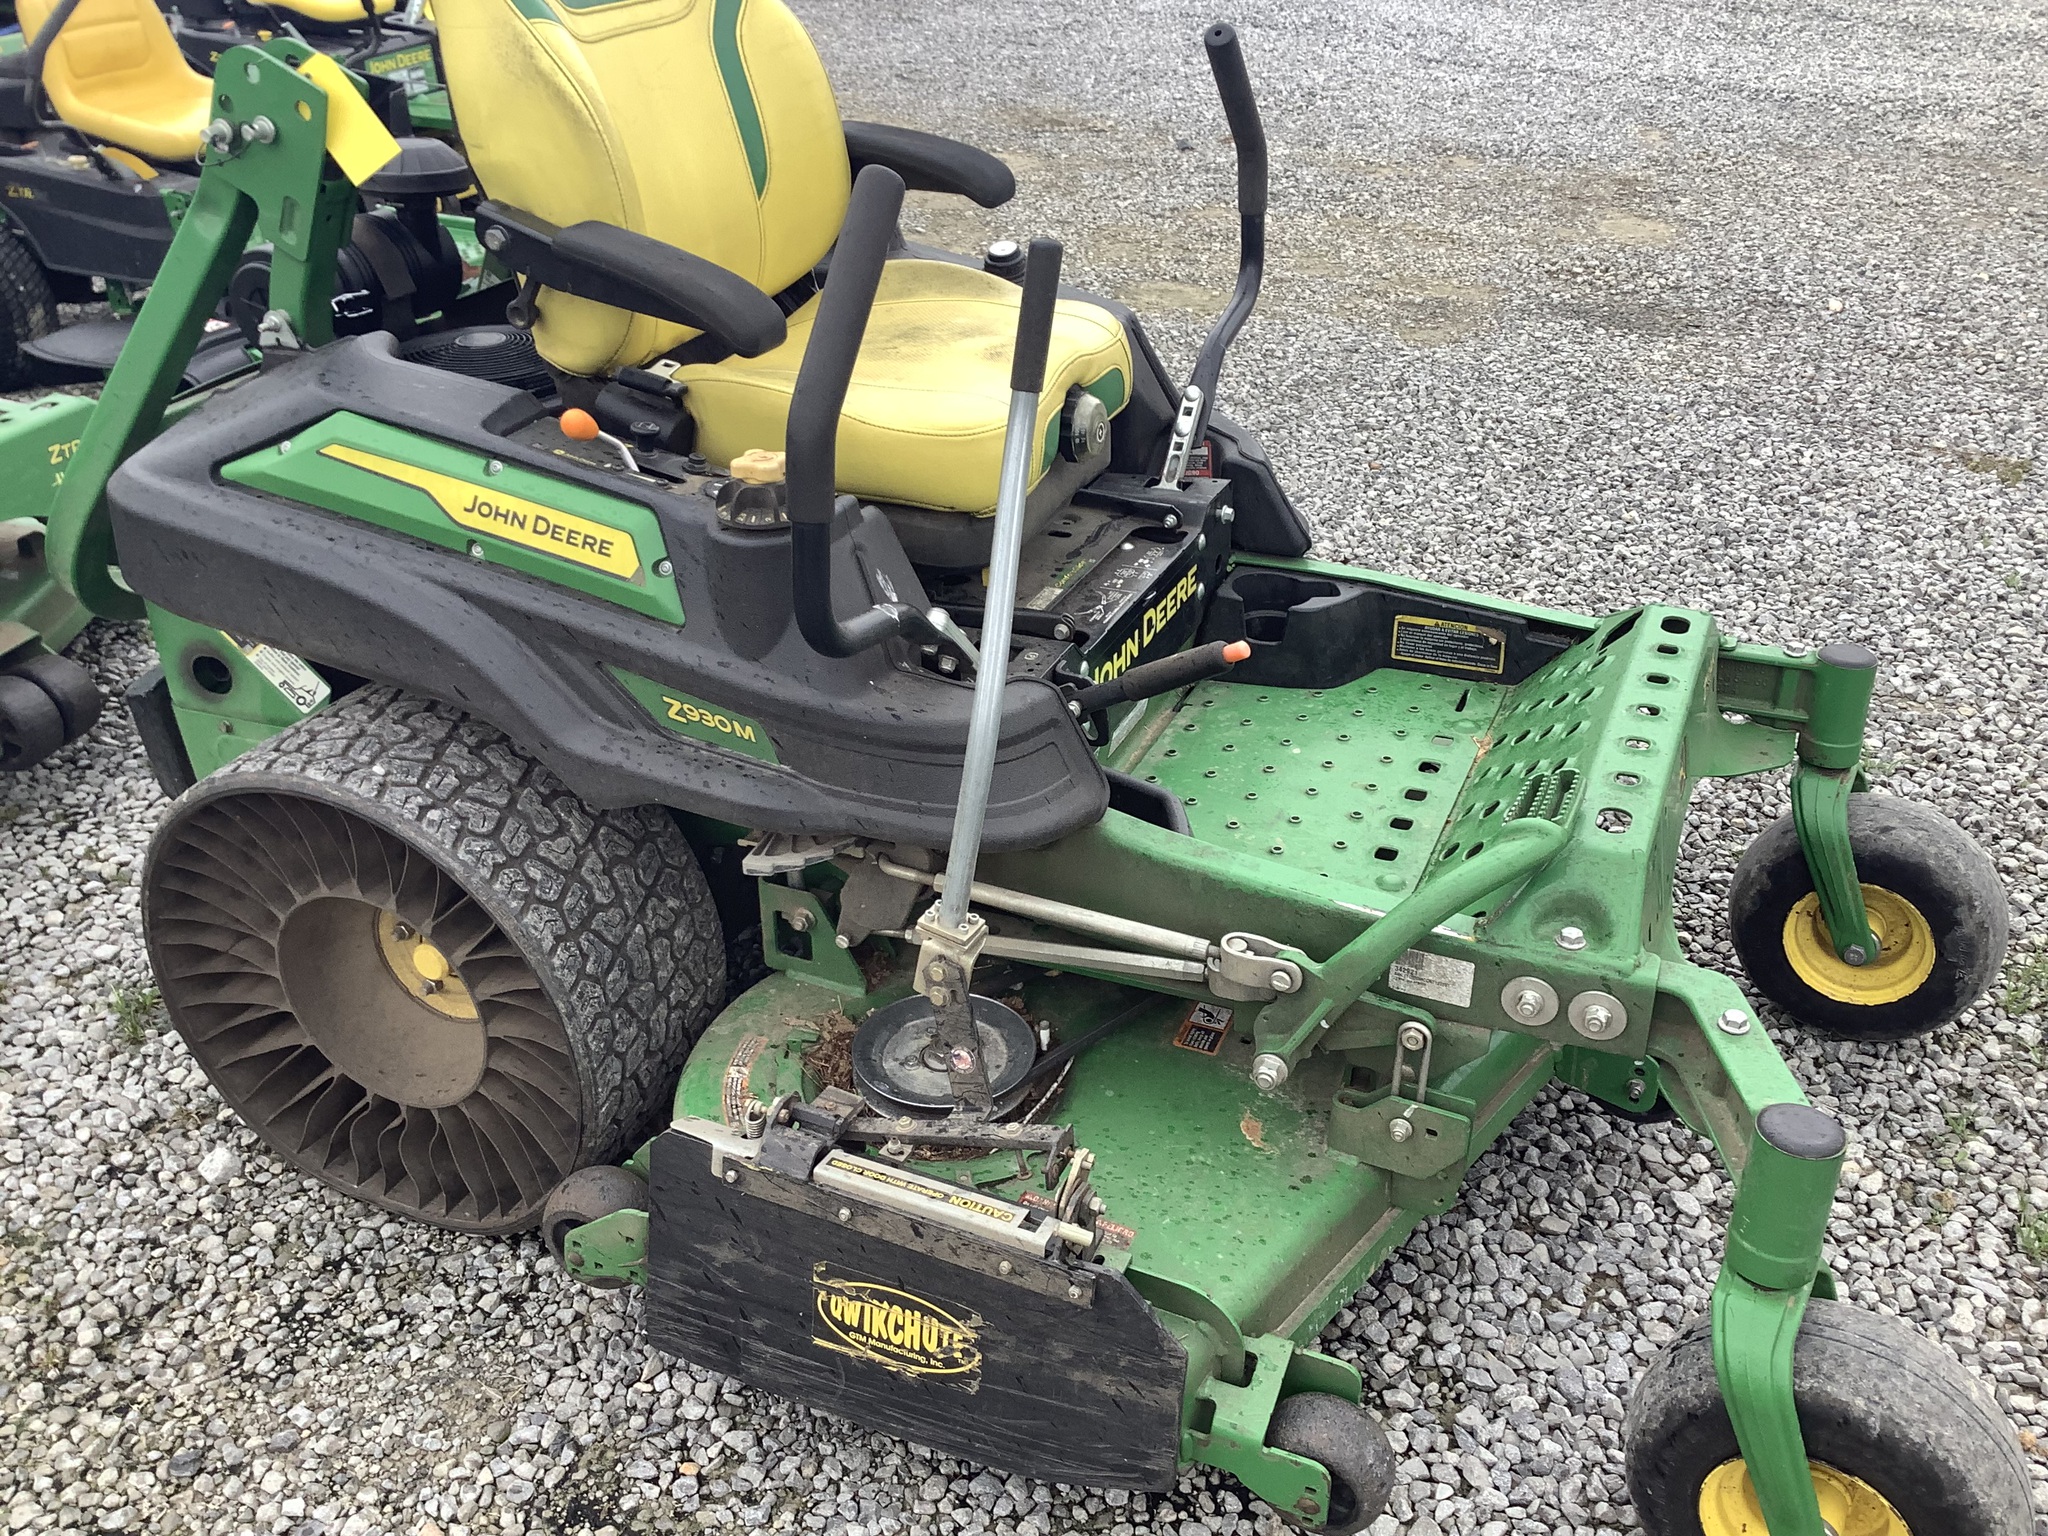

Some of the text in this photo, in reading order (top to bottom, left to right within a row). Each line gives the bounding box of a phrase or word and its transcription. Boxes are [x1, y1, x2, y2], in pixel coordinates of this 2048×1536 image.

[397, 48, 432, 67] DEERE
[463, 494, 614, 558] JOHN DEERE
[1094, 628, 1140, 685] JOHN
[1143, 563, 1198, 648] DEERE
[831, 1159, 863, 1175] CLOSED
[862, 1170, 887, 1182] DOOR
[886, 1177, 908, 1188] WITH
[907, 1182, 945, 1199] OPERATE
[949, 1195, 1013, 1222] CAUTION
[848, 1331, 867, 1343] GTM
[930, 1358, 946, 1369] Inc.
